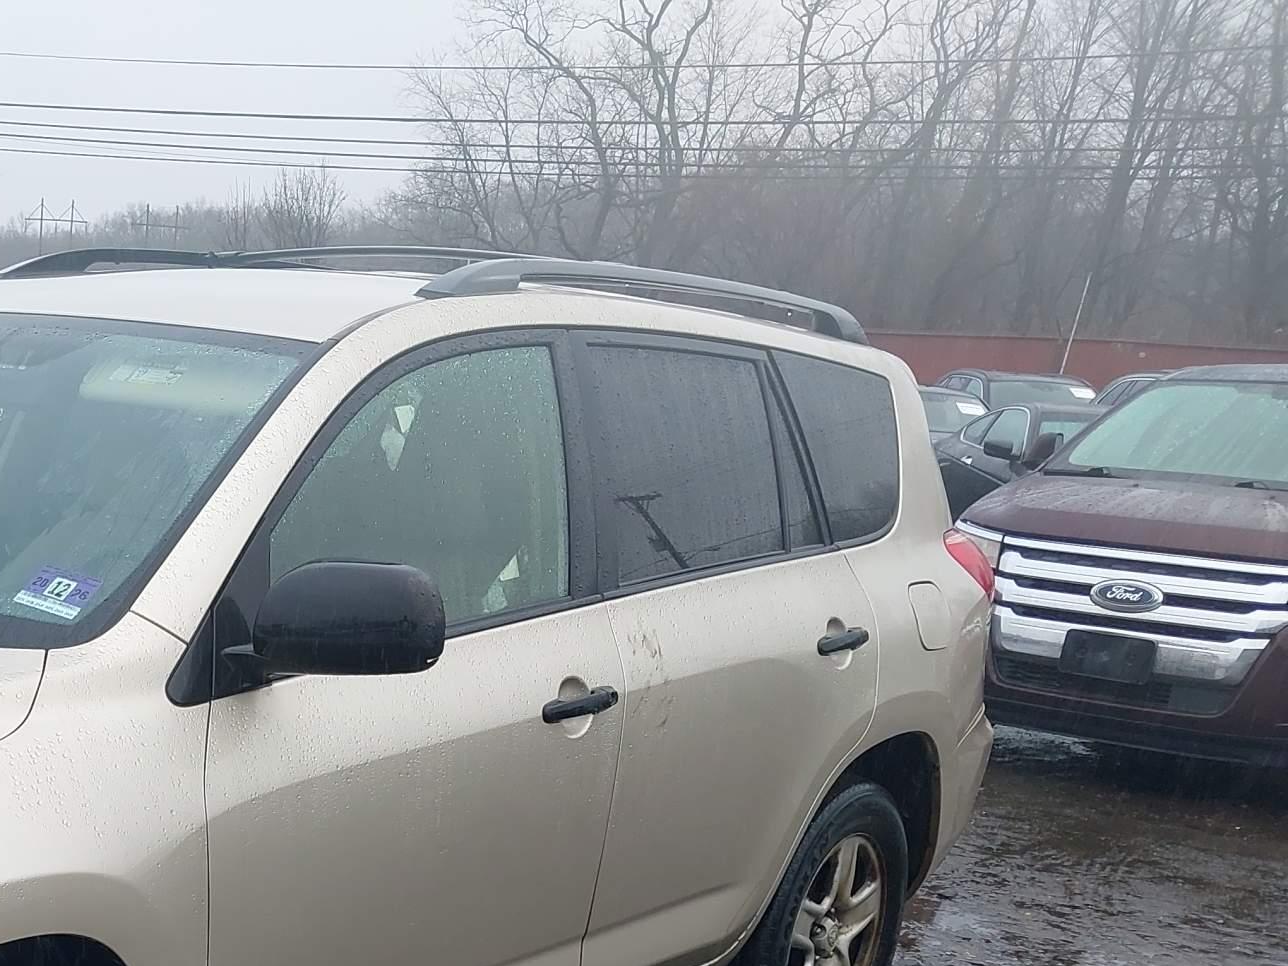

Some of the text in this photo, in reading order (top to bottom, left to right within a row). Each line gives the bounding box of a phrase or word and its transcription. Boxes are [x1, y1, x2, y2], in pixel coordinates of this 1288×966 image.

[32, 576, 90, 601] 20 12 26
[1106, 585, 1143, 602] Ford
